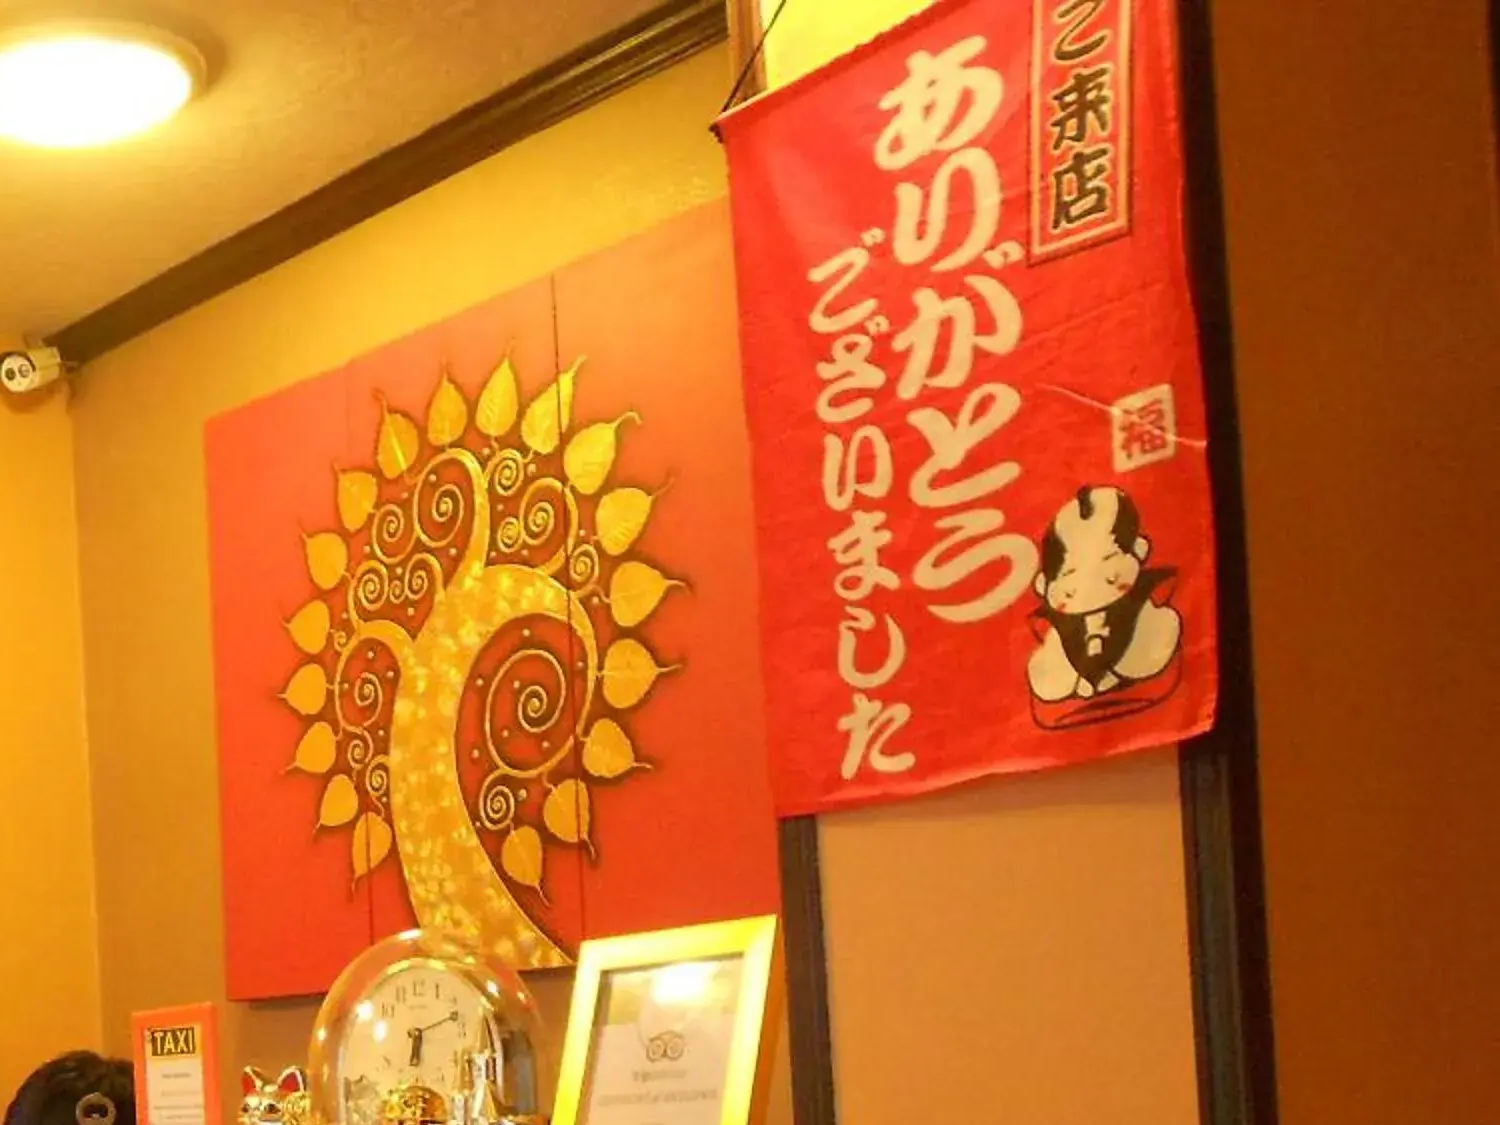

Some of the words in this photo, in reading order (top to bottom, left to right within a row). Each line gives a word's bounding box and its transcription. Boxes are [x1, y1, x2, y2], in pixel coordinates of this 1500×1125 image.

[807, 227, 916, 780] ございました
[873, 34, 1039, 623] ありがとう
[153, 1030, 193, 1054] TAXI
